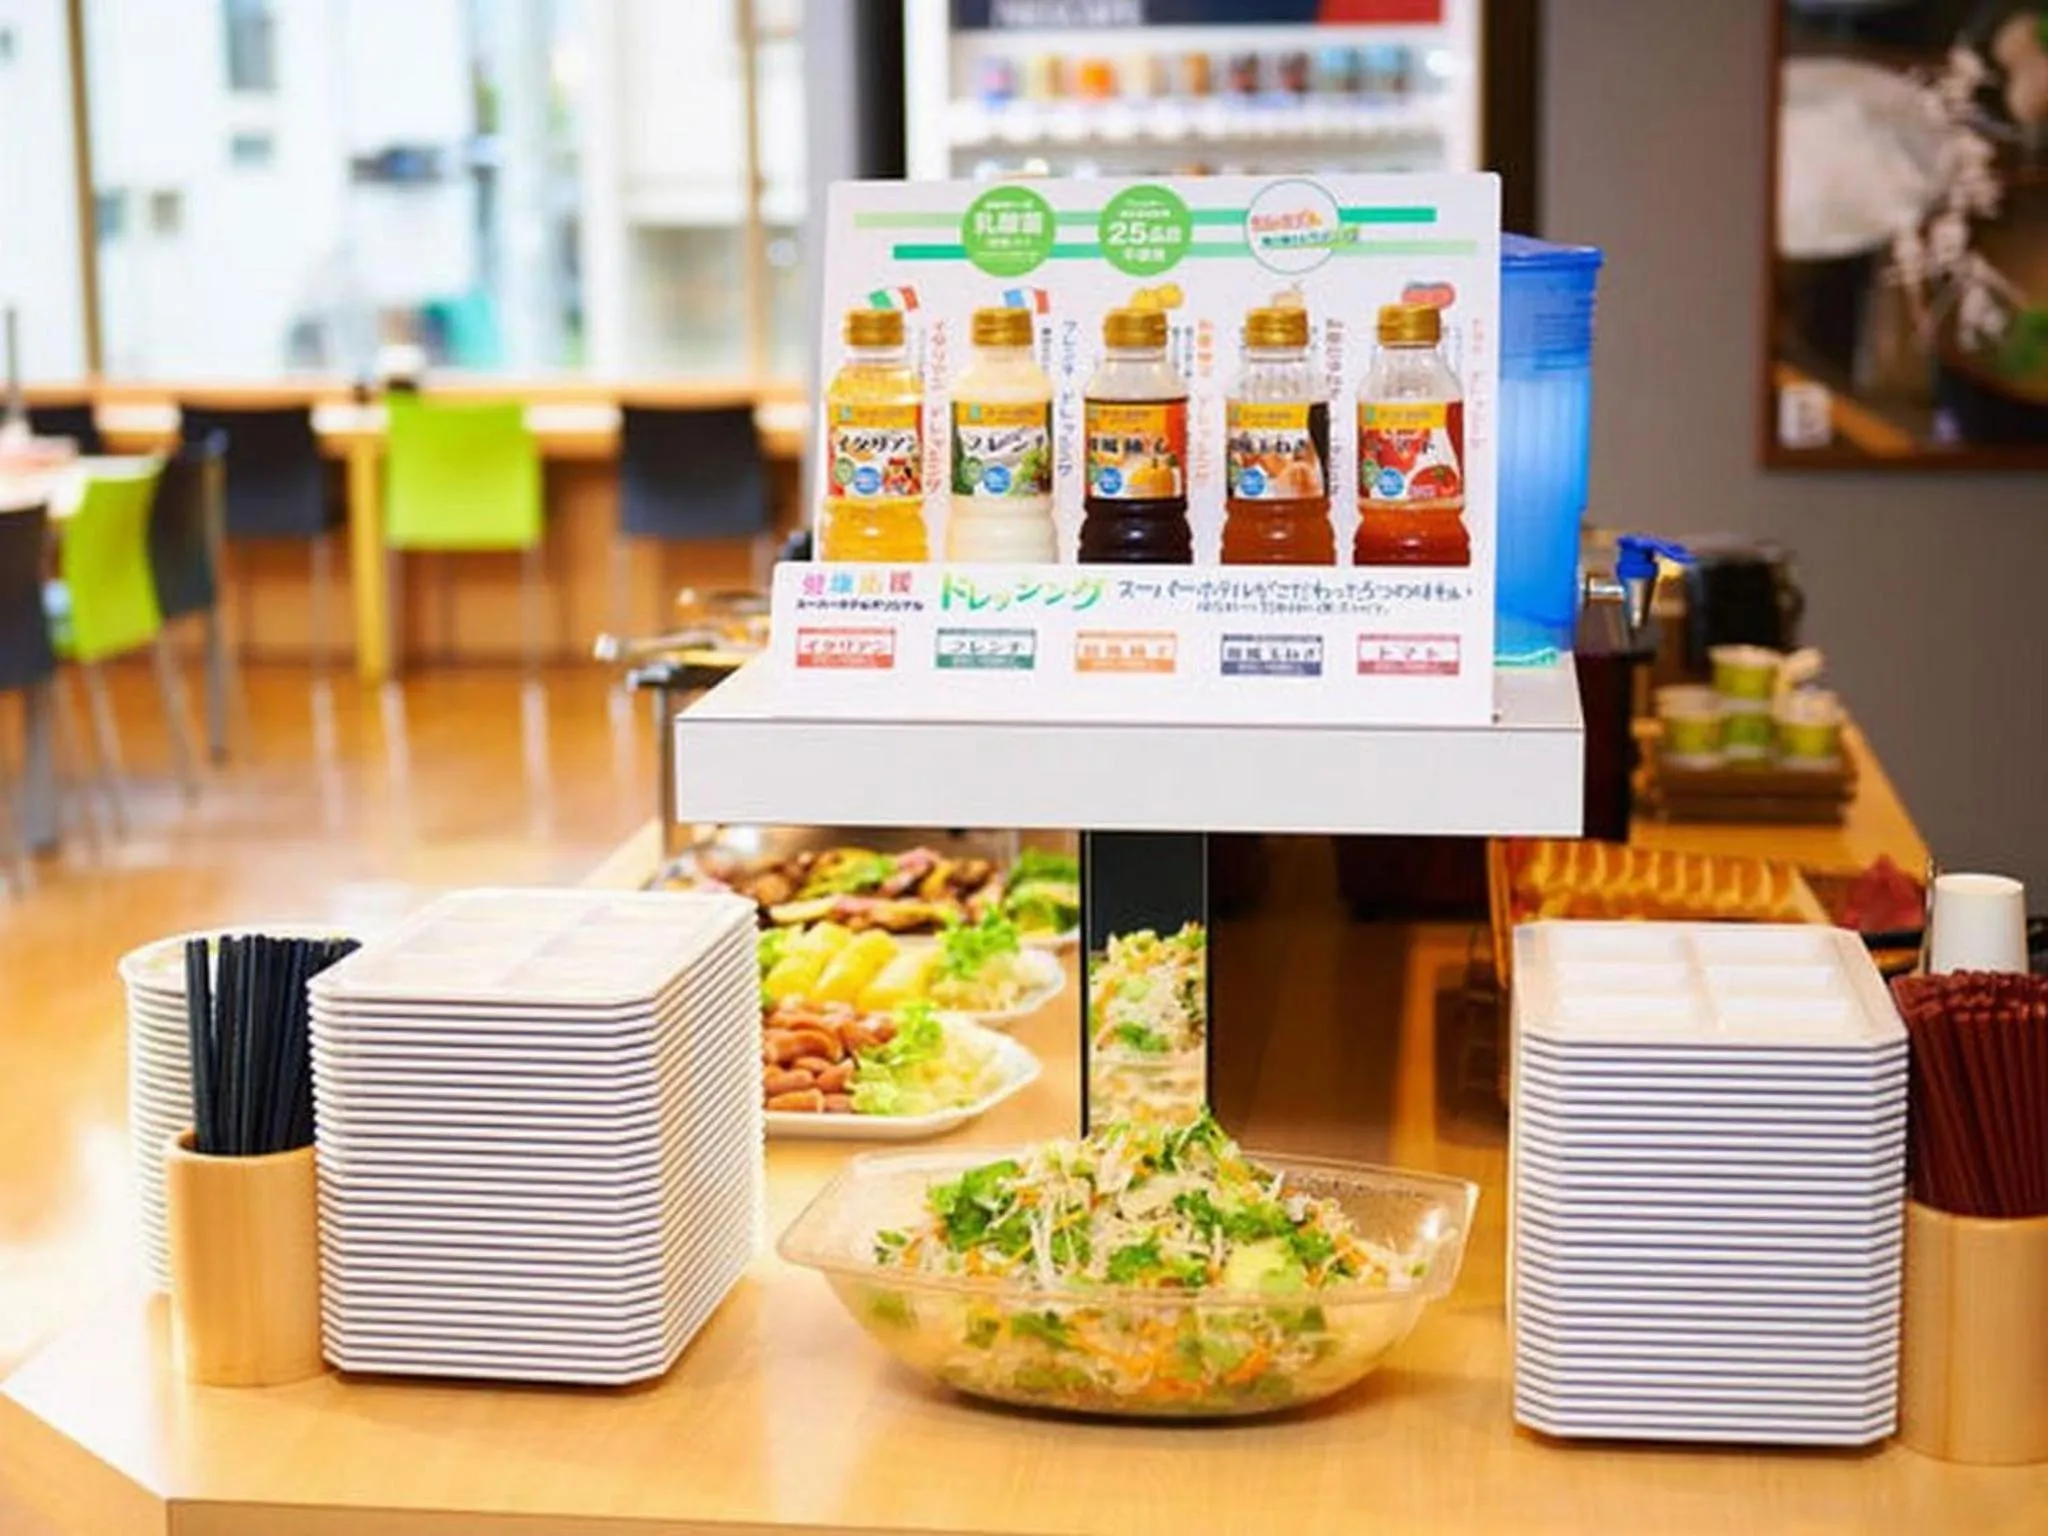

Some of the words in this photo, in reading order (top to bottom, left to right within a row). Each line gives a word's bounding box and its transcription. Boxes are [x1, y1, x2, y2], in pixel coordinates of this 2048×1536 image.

[941, 572, 1105, 611] ドレッシング
[804, 639, 888, 654] イタリアン
[952, 640, 1025, 654] フレンチ
[1378, 645, 1441, 660] トマト
